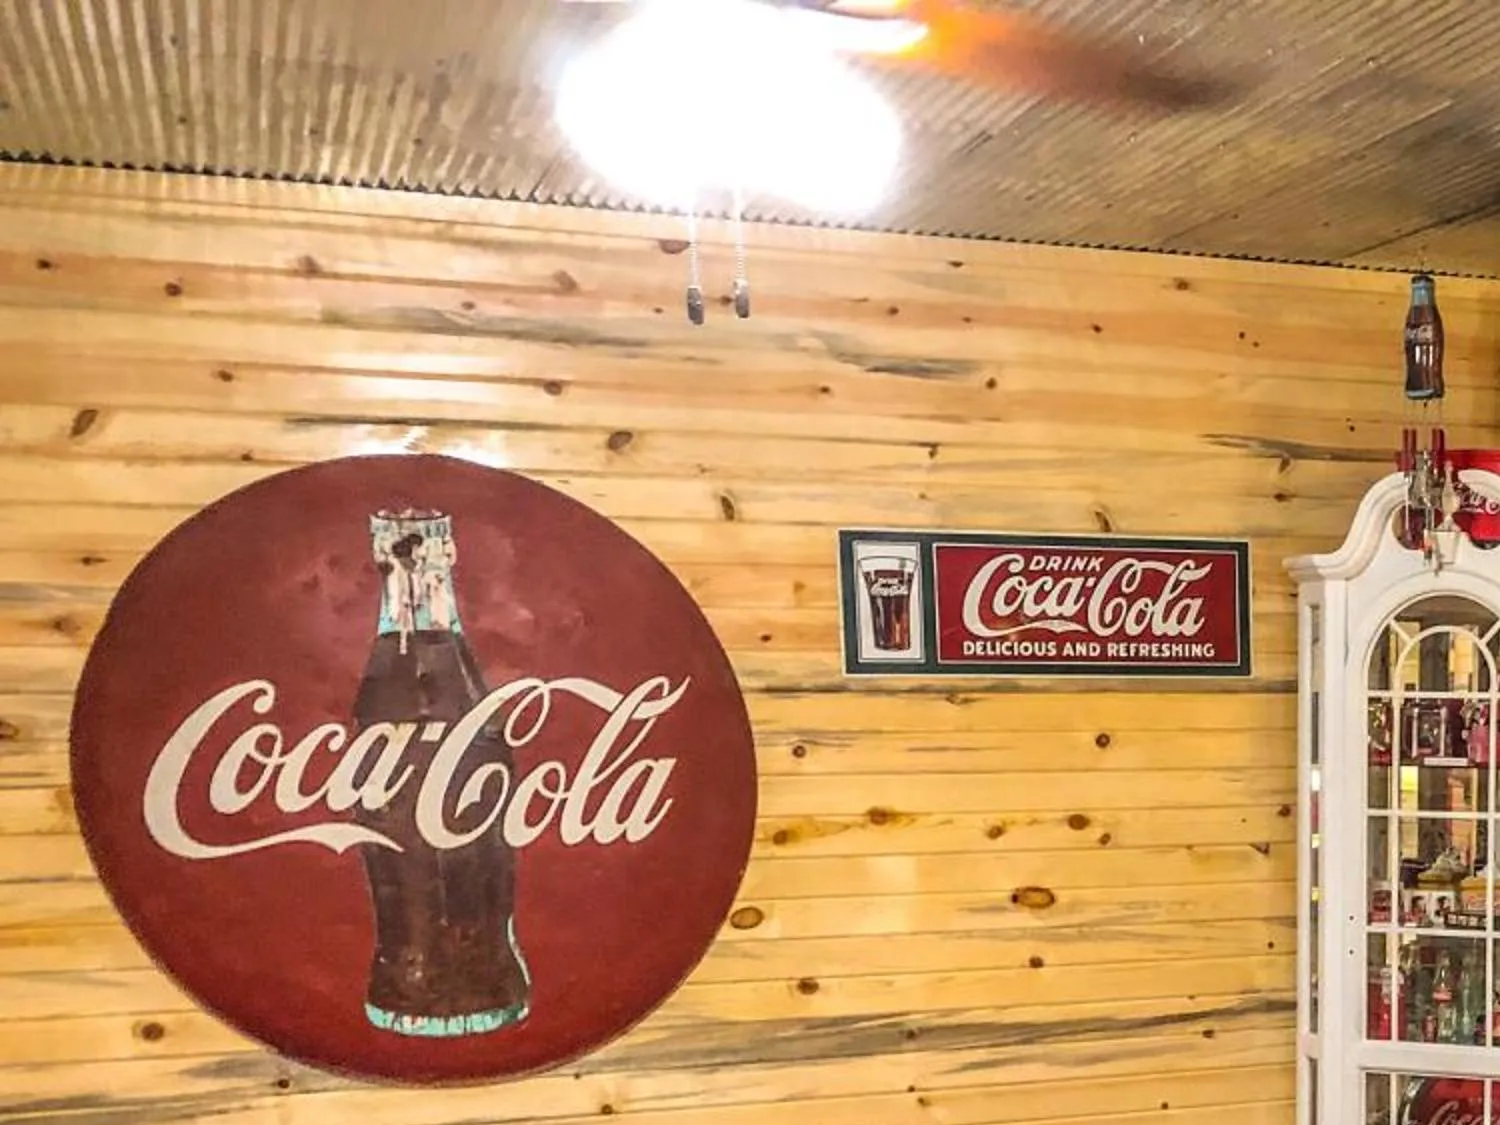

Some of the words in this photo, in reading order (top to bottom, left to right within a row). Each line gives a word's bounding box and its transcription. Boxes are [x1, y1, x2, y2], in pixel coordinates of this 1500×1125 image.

[1028, 555, 1105, 572] DRINK
[962, 553, 1213, 638] Coca-Cola
[962, 640, 1057, 657] DELICIOUS
[1062, 641, 1101, 658] AND
[1107, 642, 1216, 659] REFRESHING
[143, 675, 691, 860] Coca-Cola
